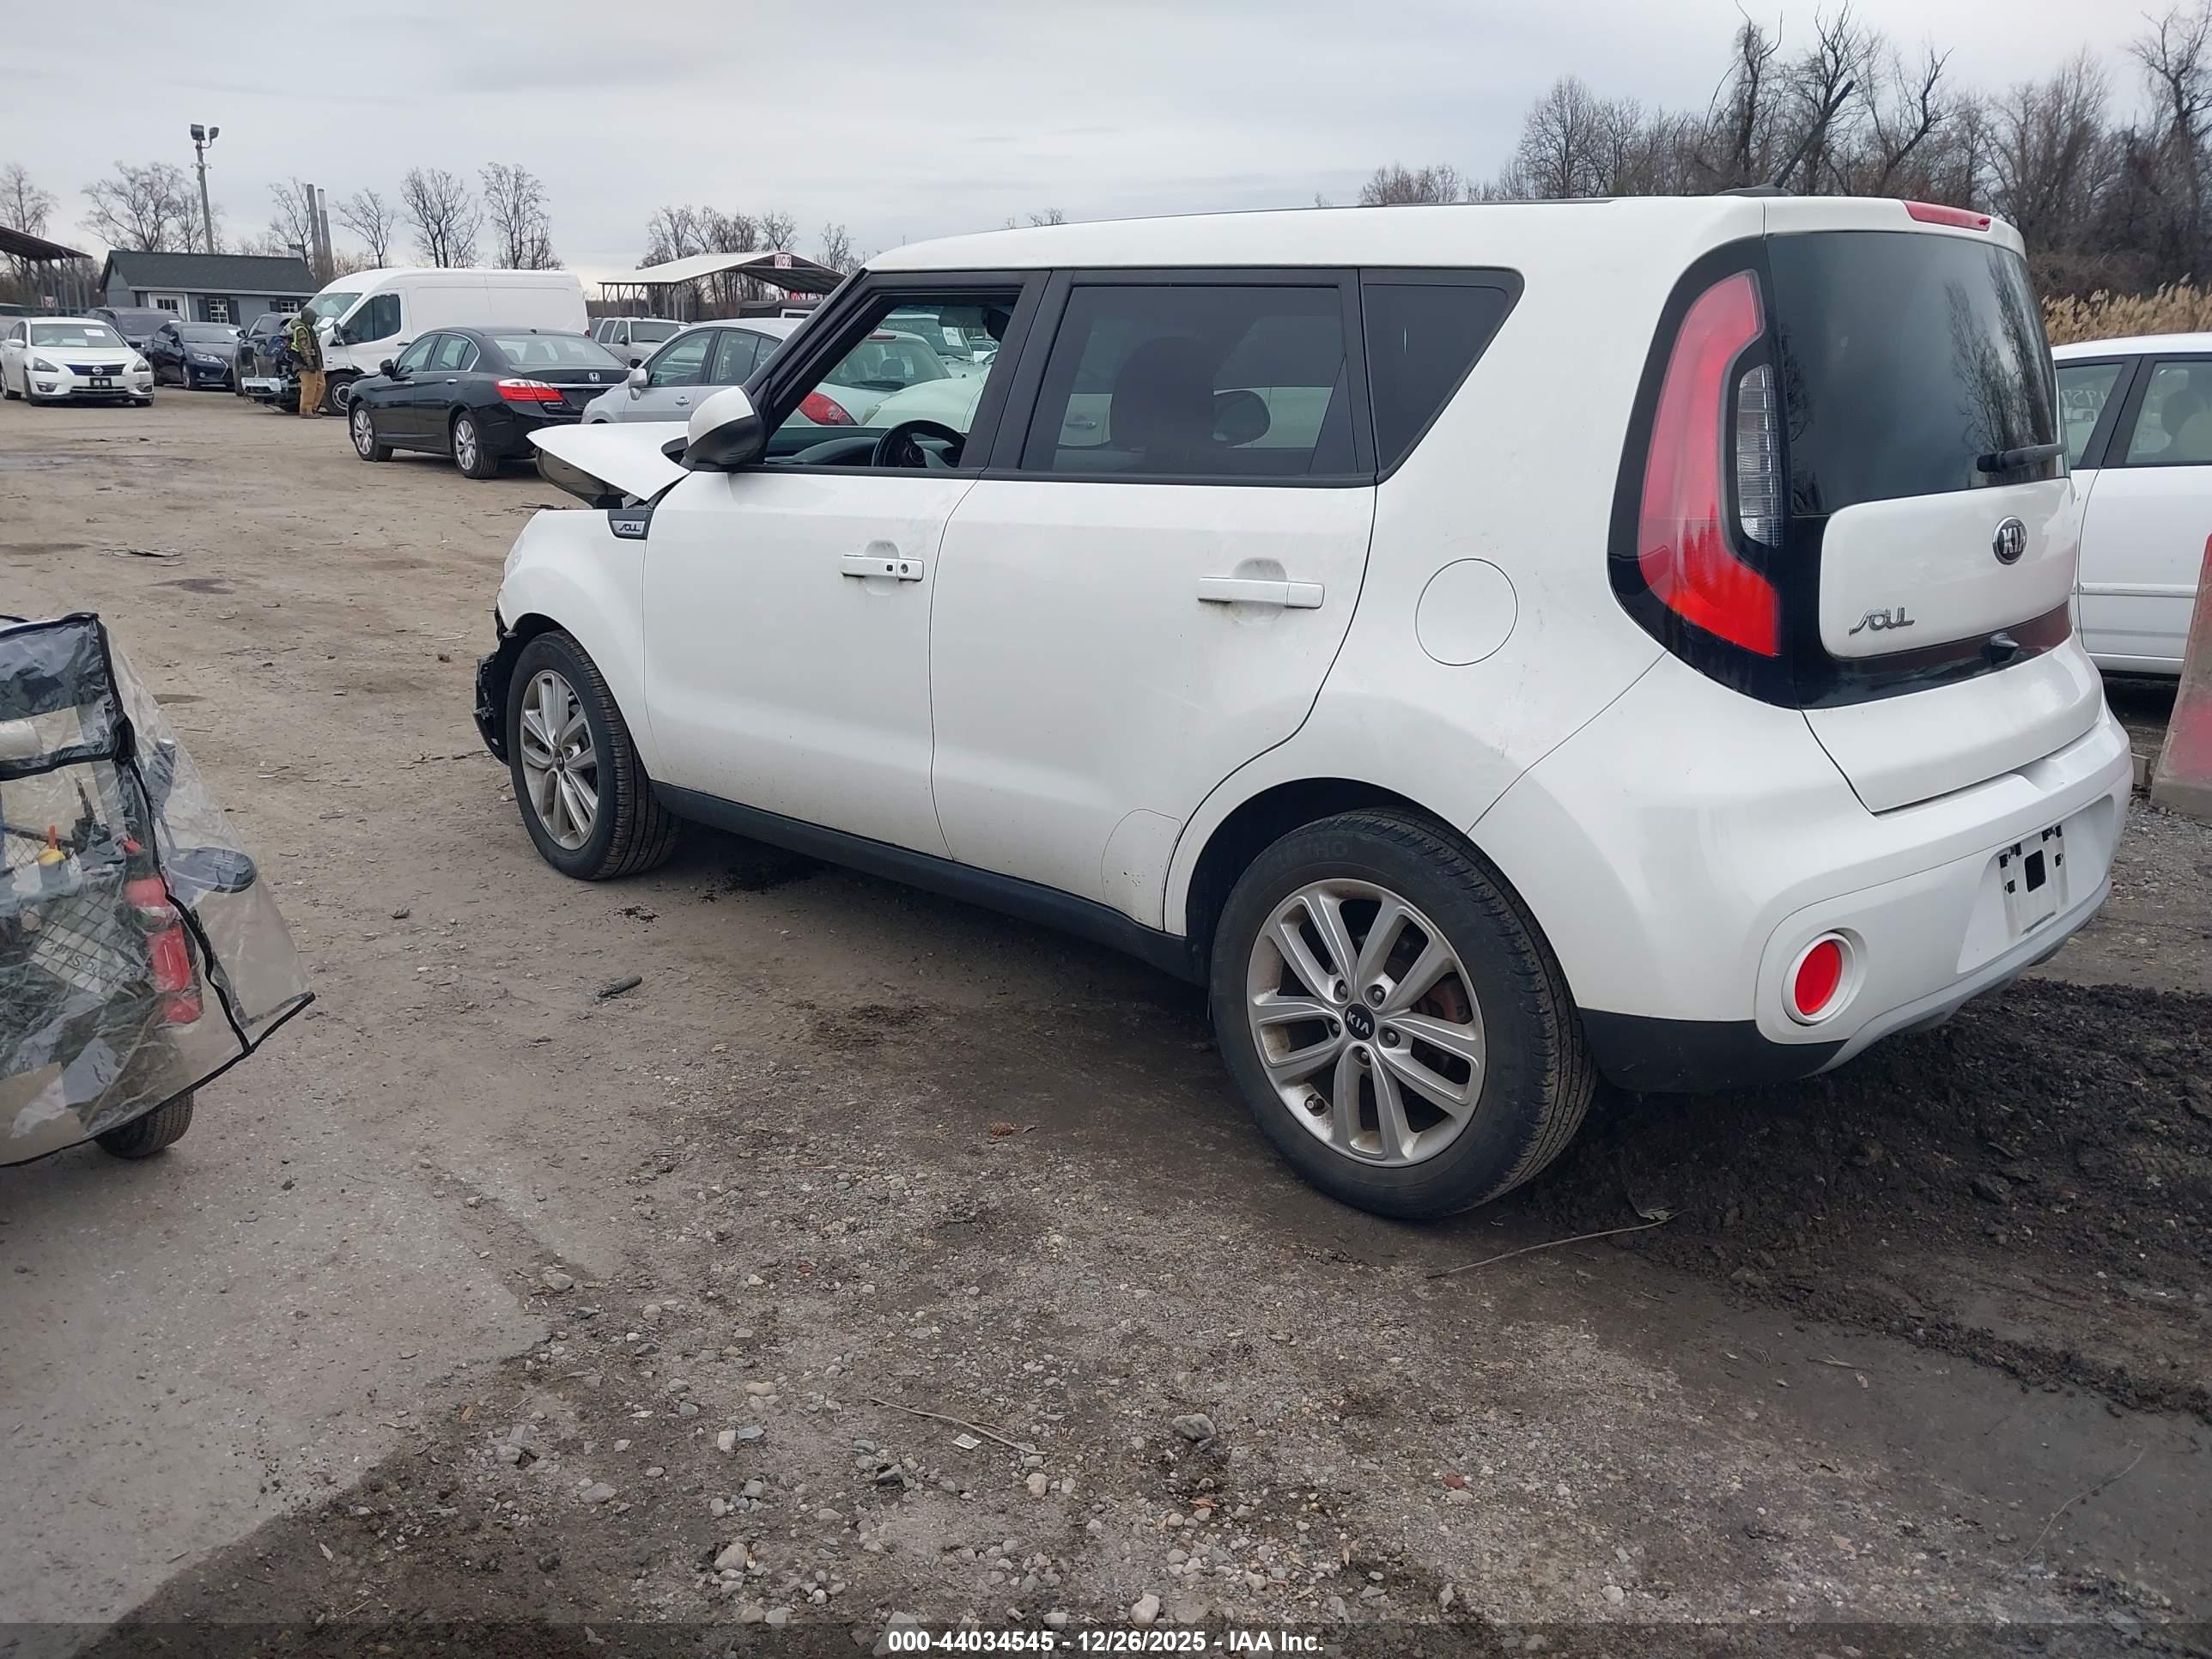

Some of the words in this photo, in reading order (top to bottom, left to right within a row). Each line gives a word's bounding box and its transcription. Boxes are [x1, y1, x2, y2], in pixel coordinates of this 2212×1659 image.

[618, 523, 641, 532] SOUL
[1848, 606, 1916, 635] SOUL
[1346, 1010, 1370, 1035] KIA
